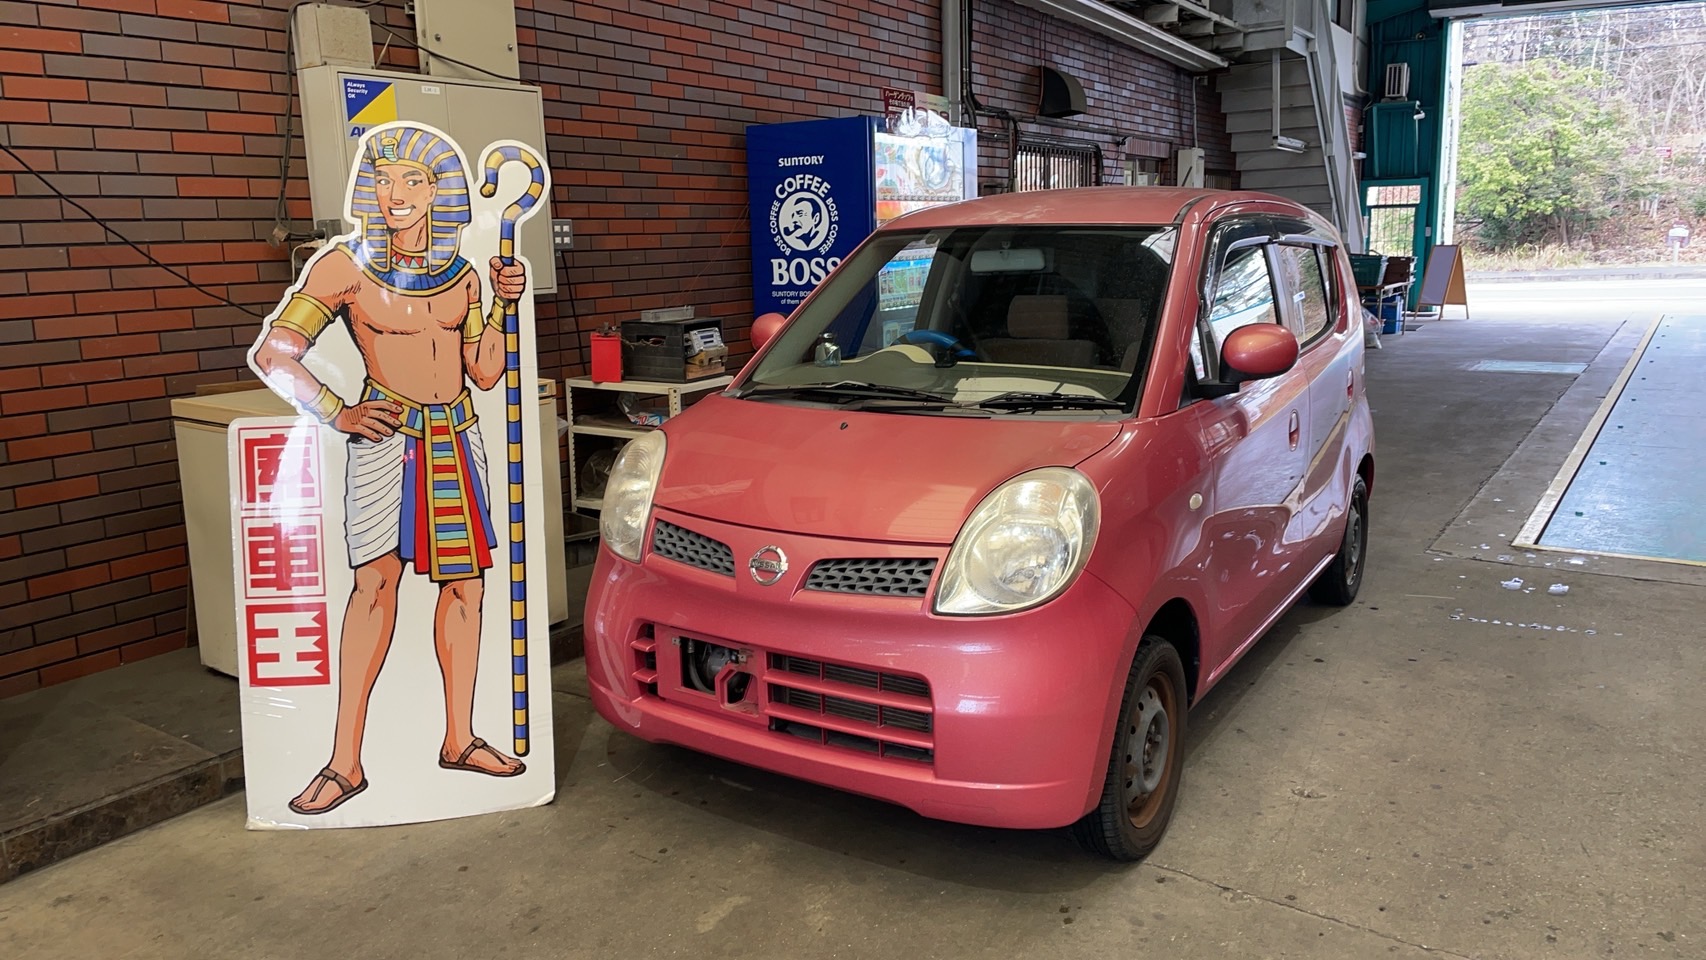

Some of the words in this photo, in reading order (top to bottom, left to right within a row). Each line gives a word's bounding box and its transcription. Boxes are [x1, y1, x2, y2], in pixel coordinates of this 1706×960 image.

[347, 87, 368, 95] Security
[778, 155, 825, 167] SUNTORY
[775, 174, 831, 199] COFFEE
[769, 199, 781, 235] COFFEE
[825, 197, 839, 222] BOSS
[773, 235, 792, 256] BOSS
[818, 223, 839, 256] COFFEE
[771, 290, 798, 298] SUNTORY
[751, 559, 783, 570] NISSAN
